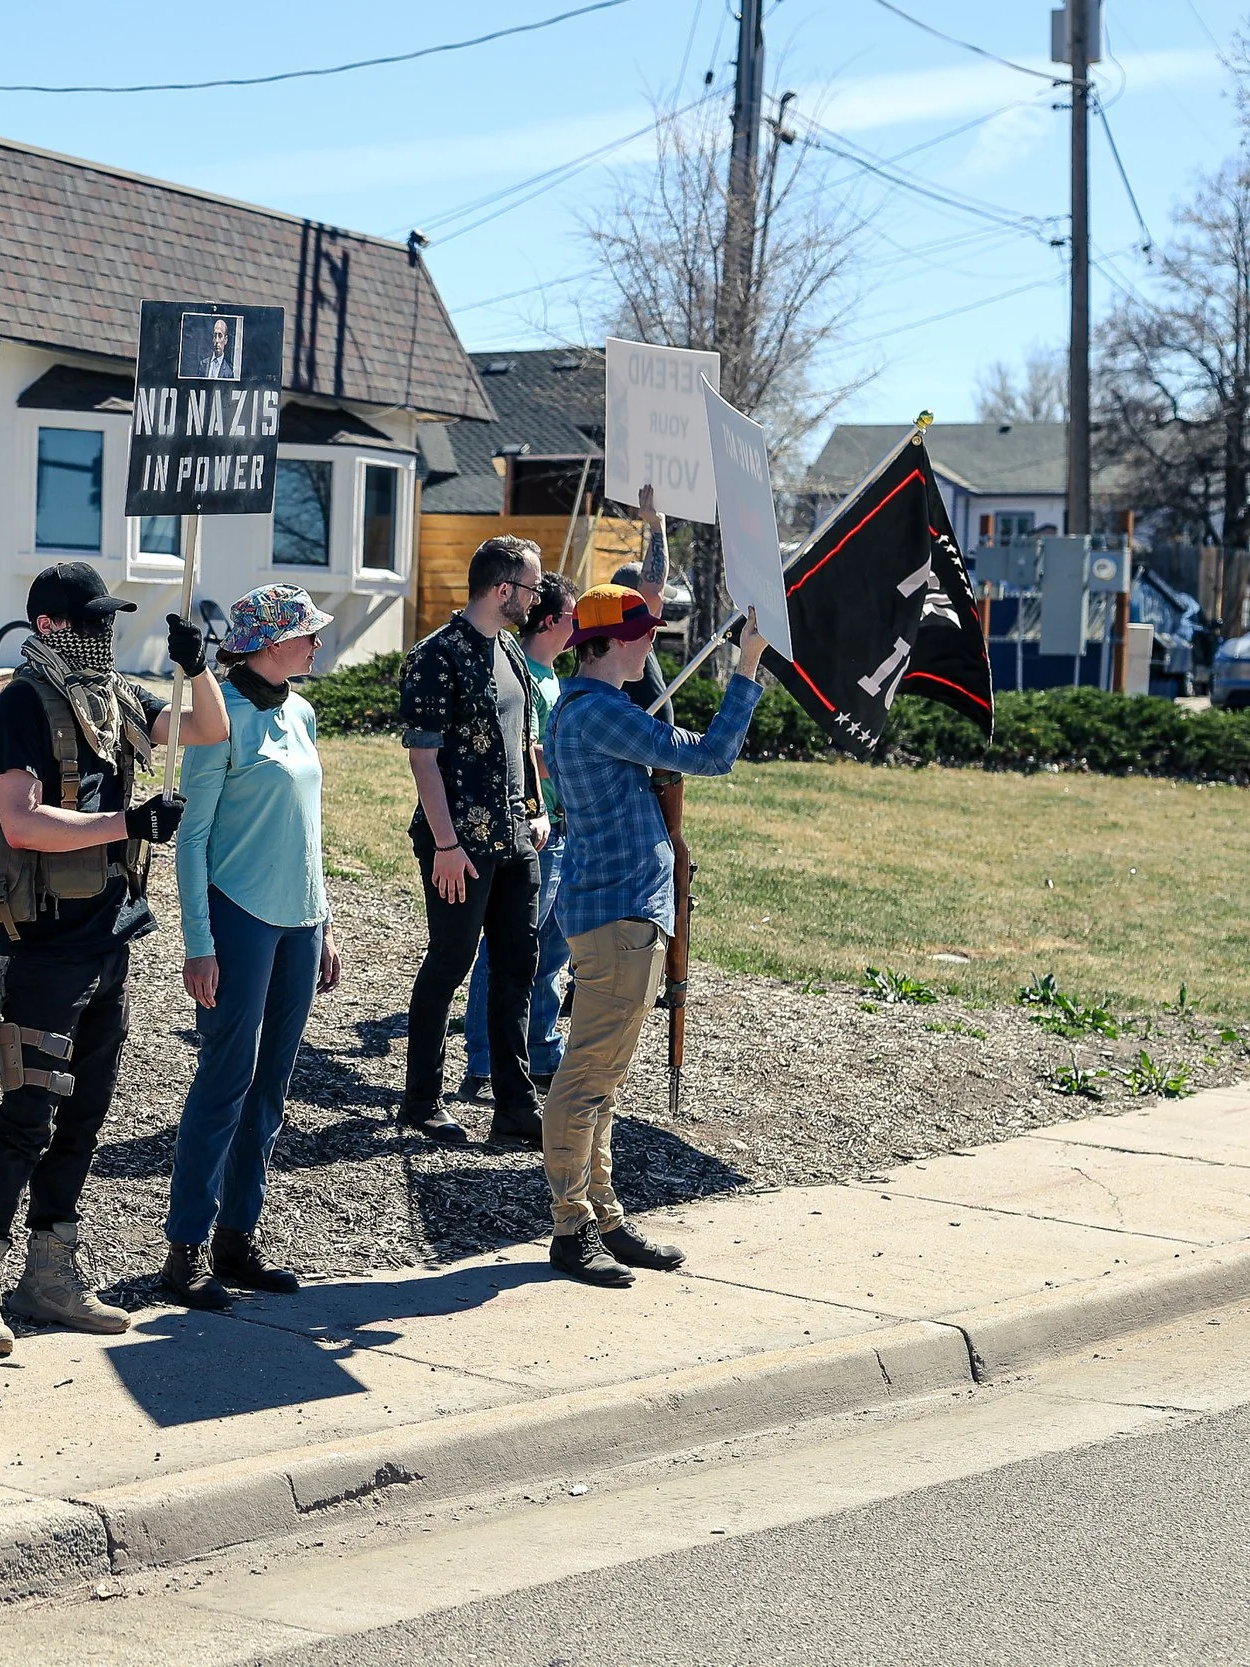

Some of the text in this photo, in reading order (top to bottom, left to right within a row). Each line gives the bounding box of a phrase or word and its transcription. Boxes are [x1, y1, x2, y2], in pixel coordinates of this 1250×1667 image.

[135, 387, 279, 436] NO NAZIS
[142, 454, 265, 492] IN POWER
[150, 810, 159, 839] HARDY
